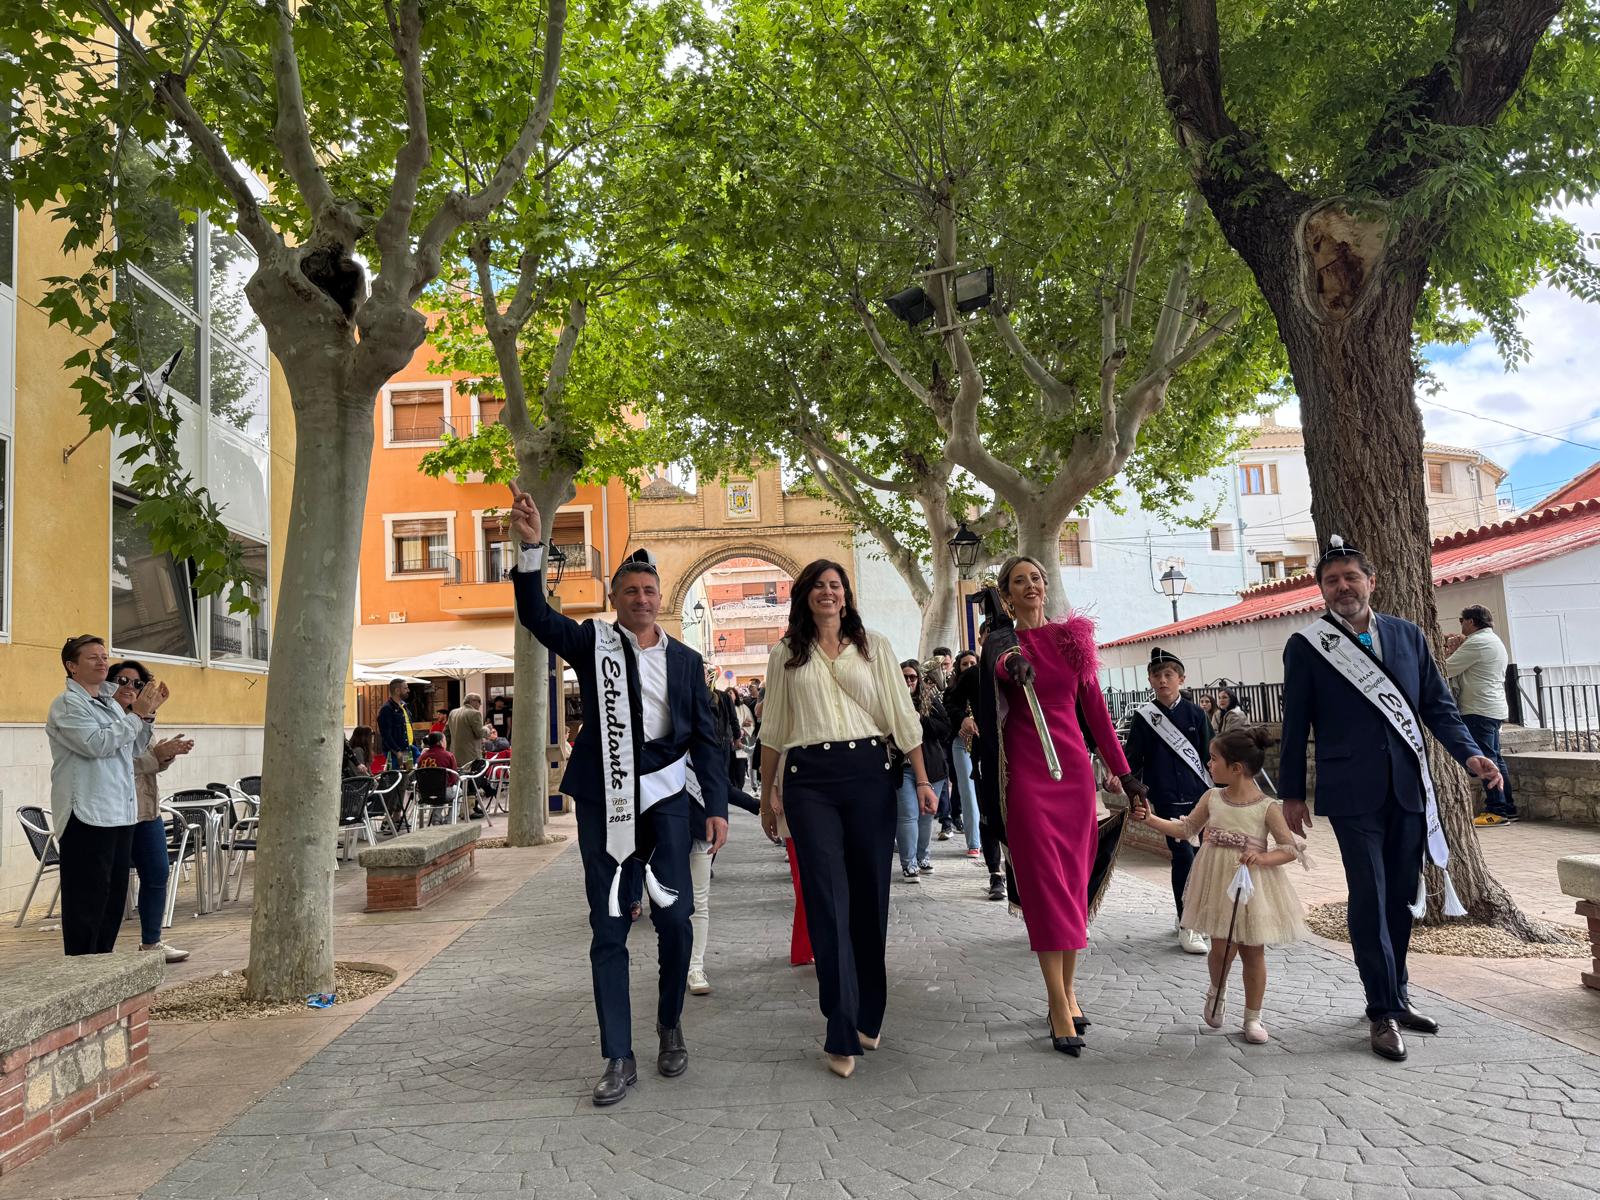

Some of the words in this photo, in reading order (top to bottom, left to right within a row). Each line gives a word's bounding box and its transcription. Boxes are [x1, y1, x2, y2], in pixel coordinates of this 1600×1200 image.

[1358, 670, 1375, 684] BIAR
[601, 656, 628, 790] Estudiants
[608, 813, 632, 823] 2025
